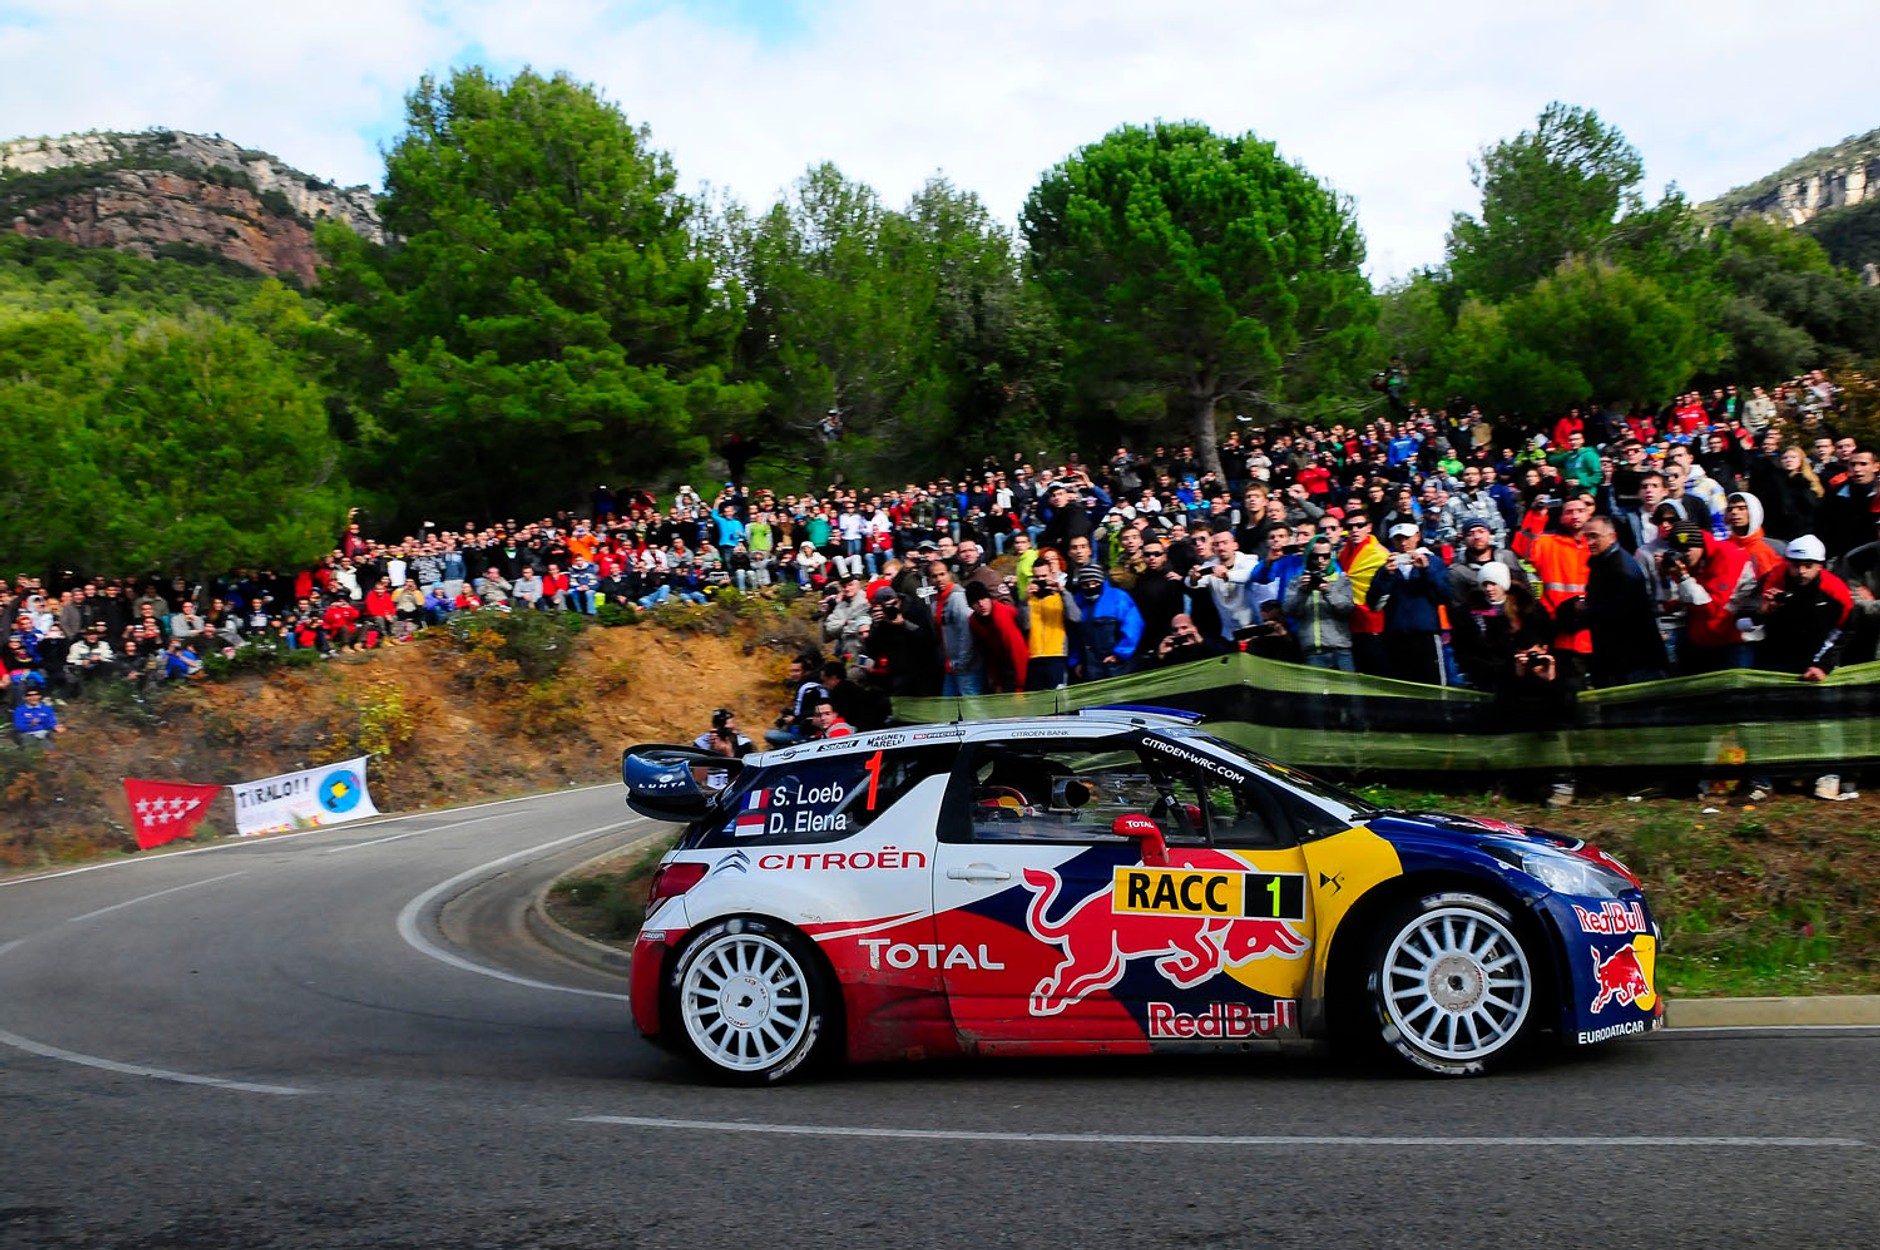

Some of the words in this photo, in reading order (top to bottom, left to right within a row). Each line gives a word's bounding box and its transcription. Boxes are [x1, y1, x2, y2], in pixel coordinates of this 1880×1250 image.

[1141, 737, 1245, 784] CITROEN-WRC.COM
[773, 786, 790, 807] S.
[796, 781, 844, 805] Loeb
[864, 749, 883, 811] 1
[769, 812, 788, 834] D.
[794, 810, 846, 832] Elena
[1126, 820, 1154, 828] TOTAL
[1127, 872, 1228, 912] RACC
[1266, 876, 1281, 917] 1
[1578, 1020, 1644, 1044] EURODATACAR
